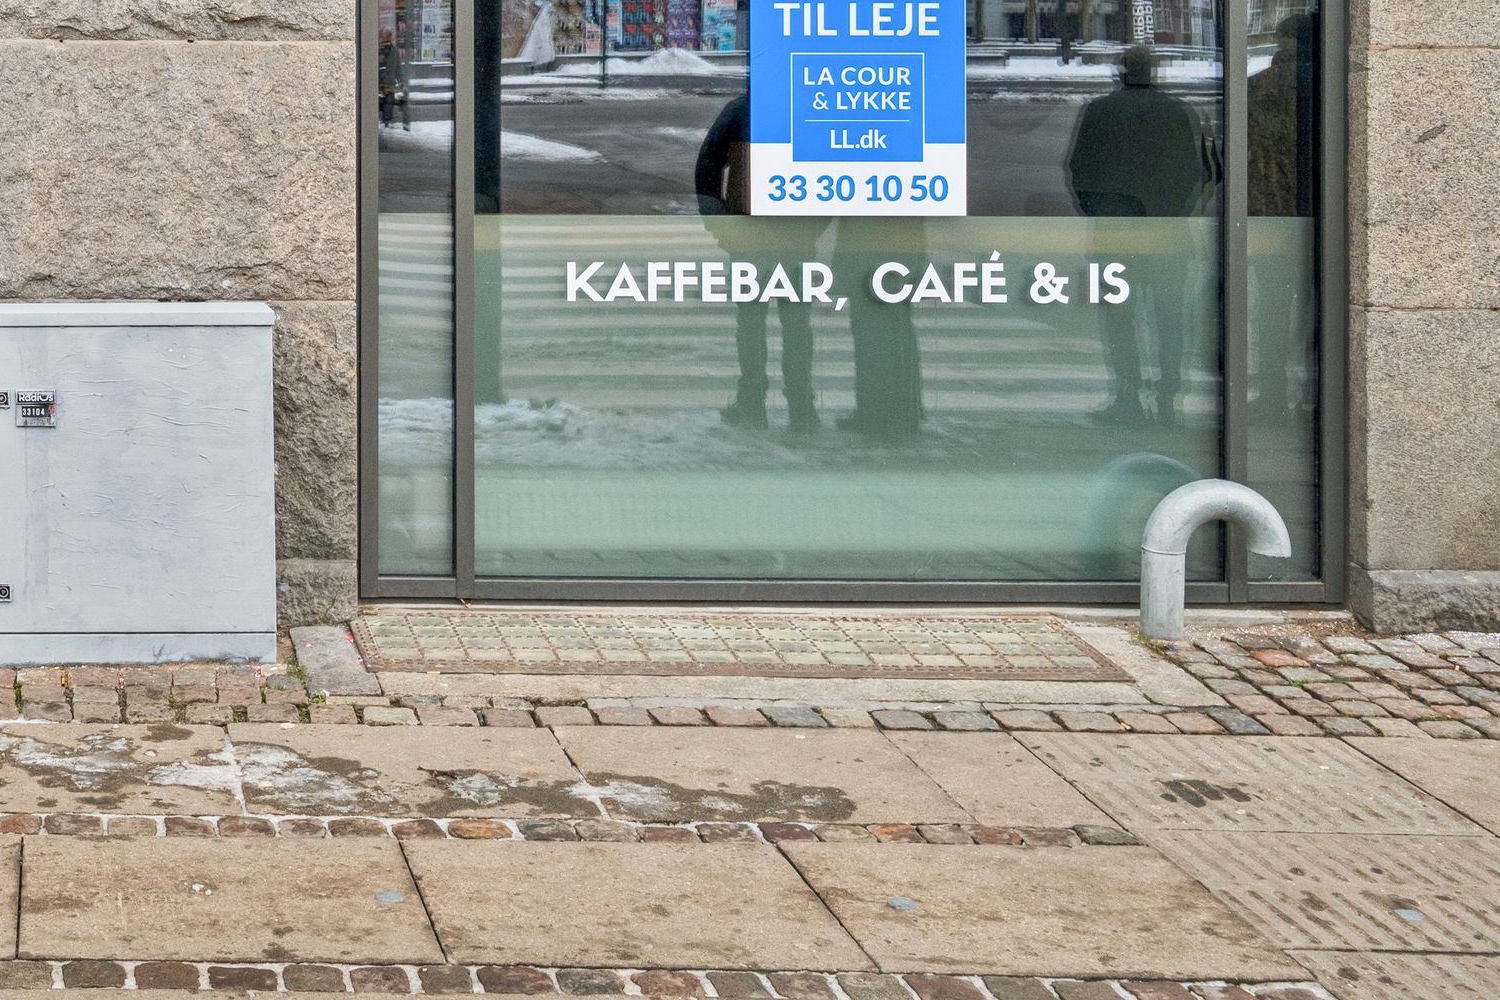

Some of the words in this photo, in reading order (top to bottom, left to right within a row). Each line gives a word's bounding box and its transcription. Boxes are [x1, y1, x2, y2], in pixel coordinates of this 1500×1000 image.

[774, 3, 837, 35] TIL
[850, 3, 939, 36] LEJE
[804, 67, 834, 85] LA
[841, 67, 910, 85] COUR
[813, 92, 828, 109] &
[837, 92, 910, 109] LYKKE
[831, 129, 886, 148] LL.dk
[768, 175, 807, 201] 33
[816, 175, 855, 201] 30
[865, 175, 902, 201] 10
[910, 175, 948, 201] 50
[567, 262, 847, 310] KAFFEBAR,
[873, 250, 1007, 303] CAFÉ
[1030, 263, 1069, 304] &
[1090, 263, 1129, 303] IS
[23, 408, 45, 416] 33104
